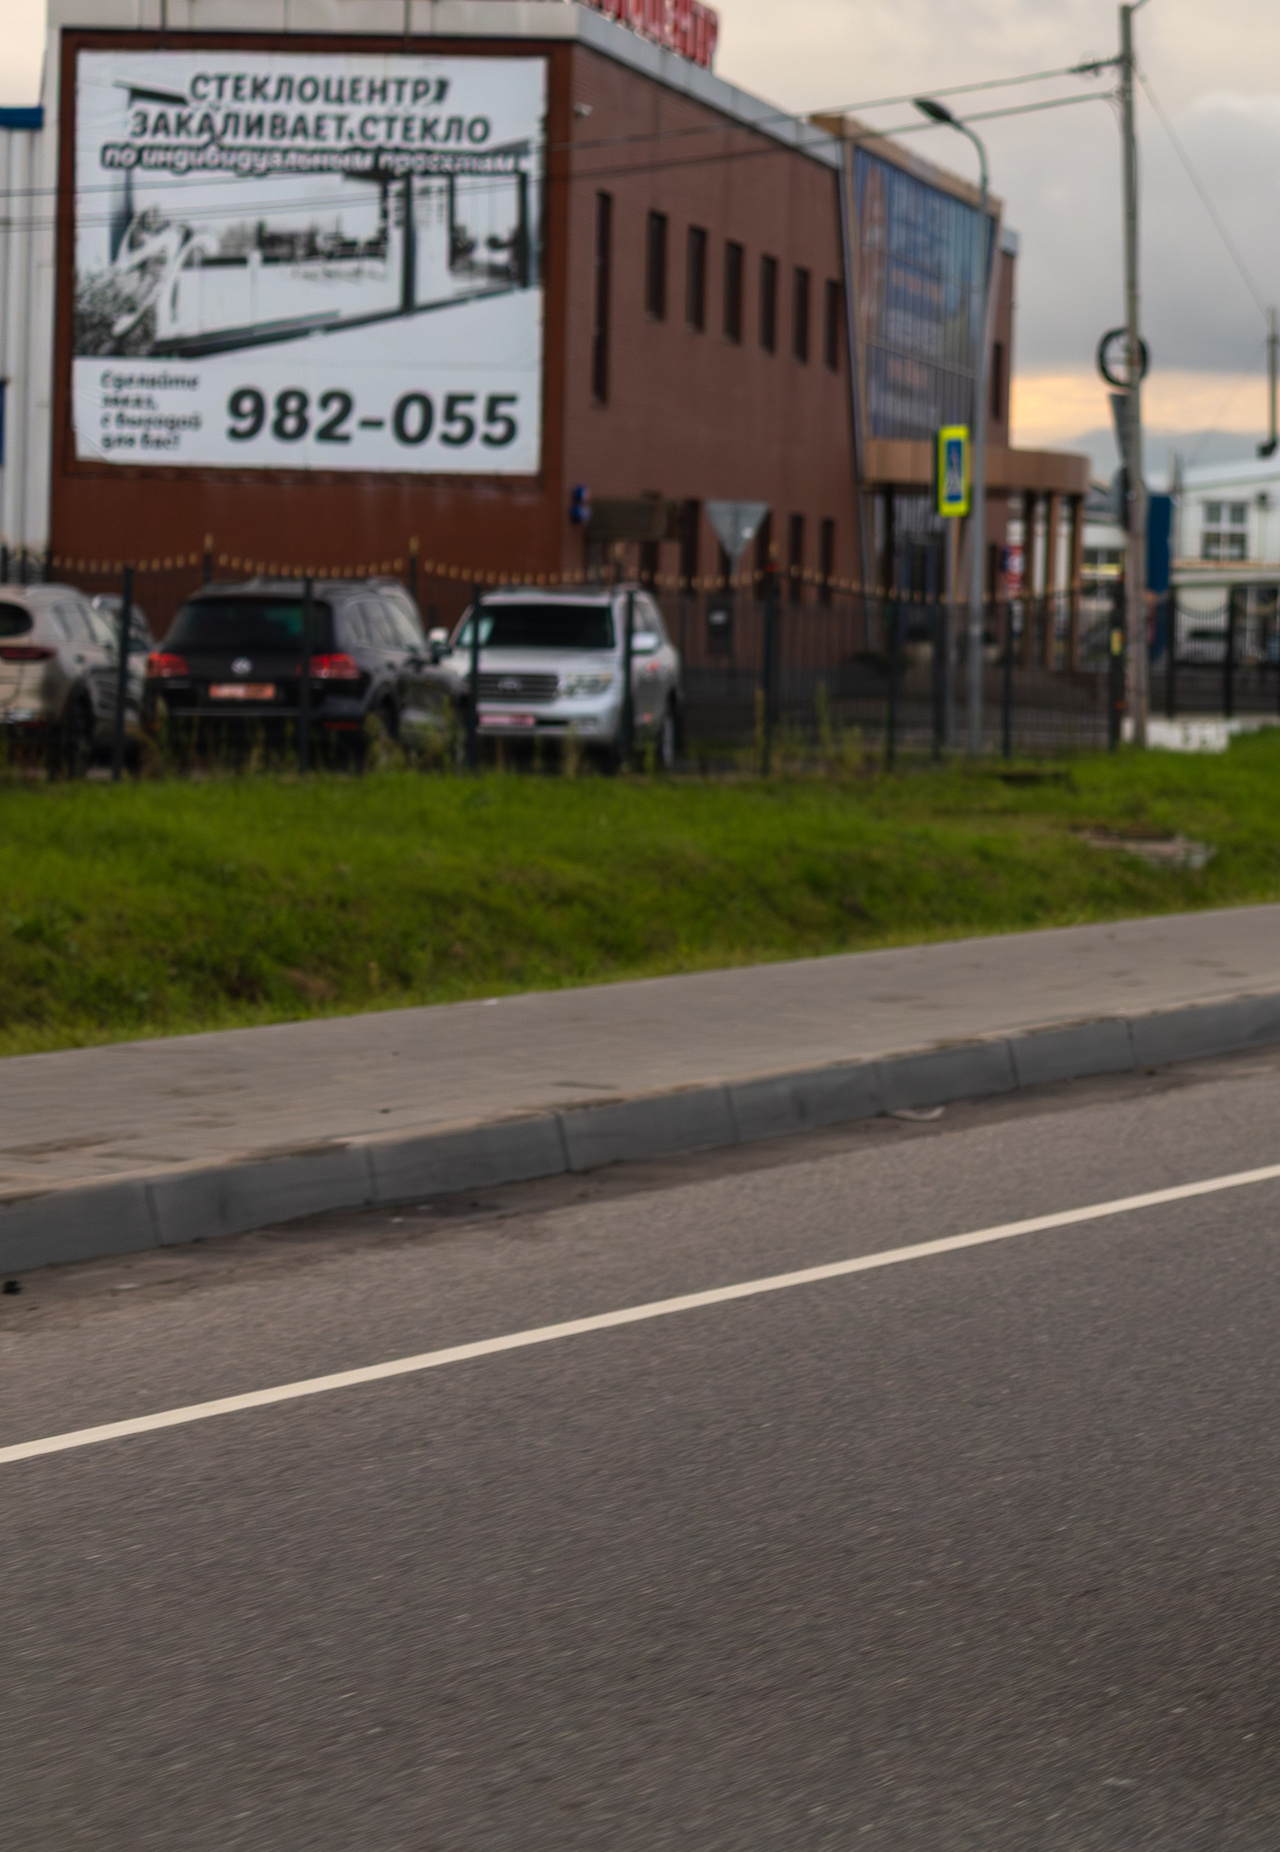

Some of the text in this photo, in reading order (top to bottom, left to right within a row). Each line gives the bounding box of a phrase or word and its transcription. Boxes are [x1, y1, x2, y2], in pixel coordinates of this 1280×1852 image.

[190, 73, 432, 105] СТЕКЛОЦЕНТР
[359, 114, 491, 144] СТЕКЛО
[104, 146, 138, 167] по
[226, 386, 518, 449] 982-055
